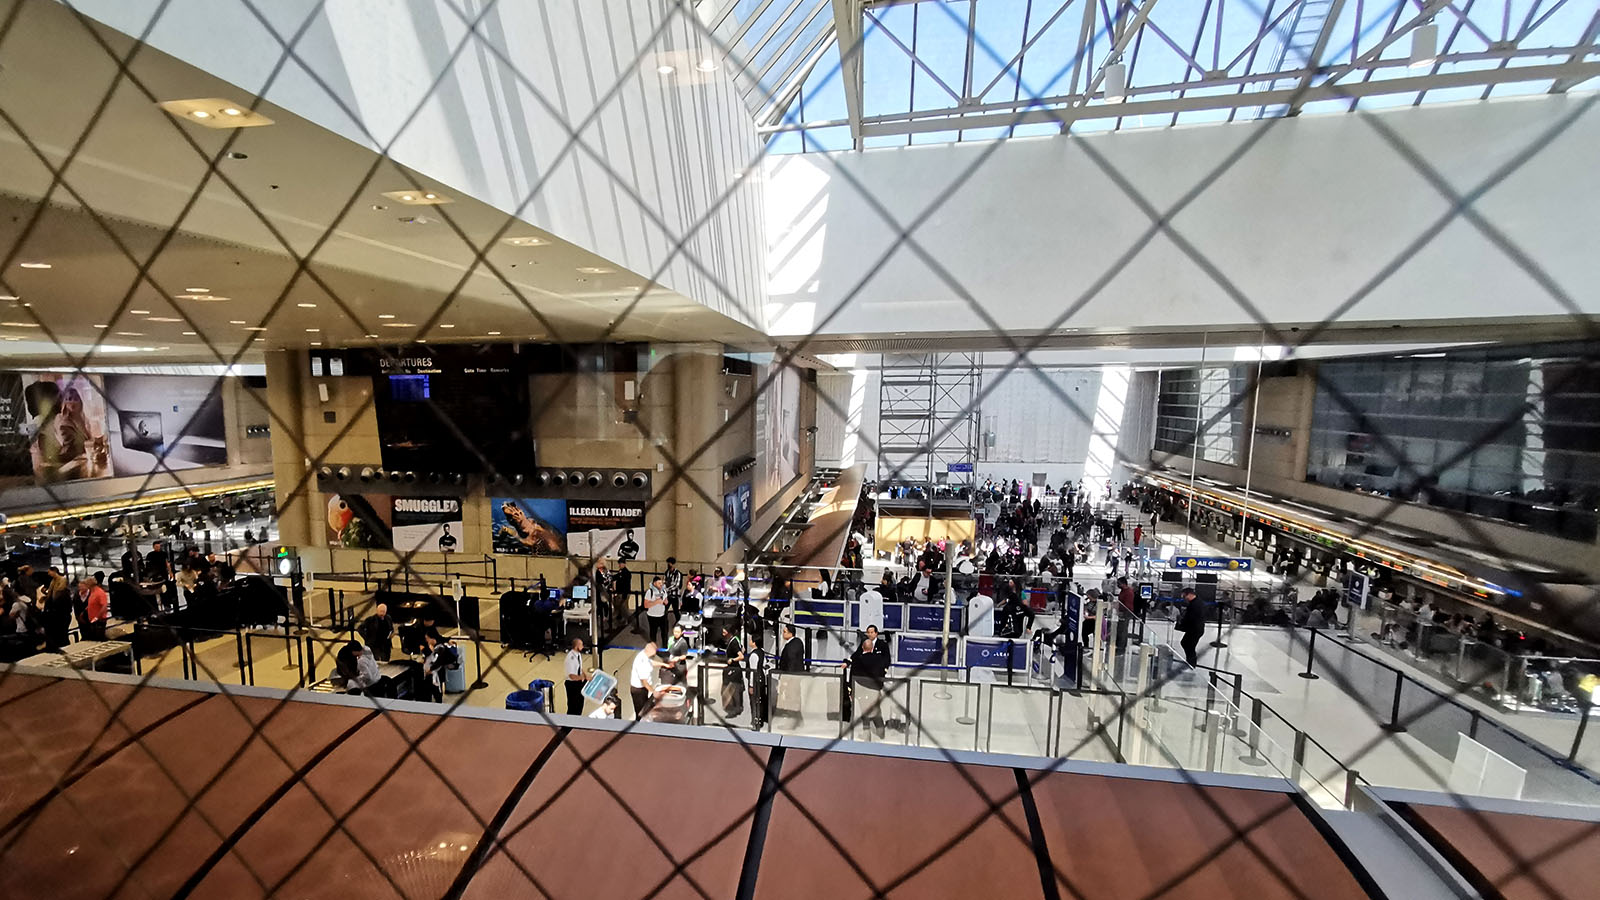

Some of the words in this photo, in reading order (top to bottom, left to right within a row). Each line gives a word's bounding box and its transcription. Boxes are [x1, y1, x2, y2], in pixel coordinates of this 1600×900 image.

[379, 358, 433, 367] DEARTURES
[394, 498, 459, 513] SMUGGLED
[569, 507, 609, 517] ILLEGALLY
[610, 508, 643, 517] TRADED
